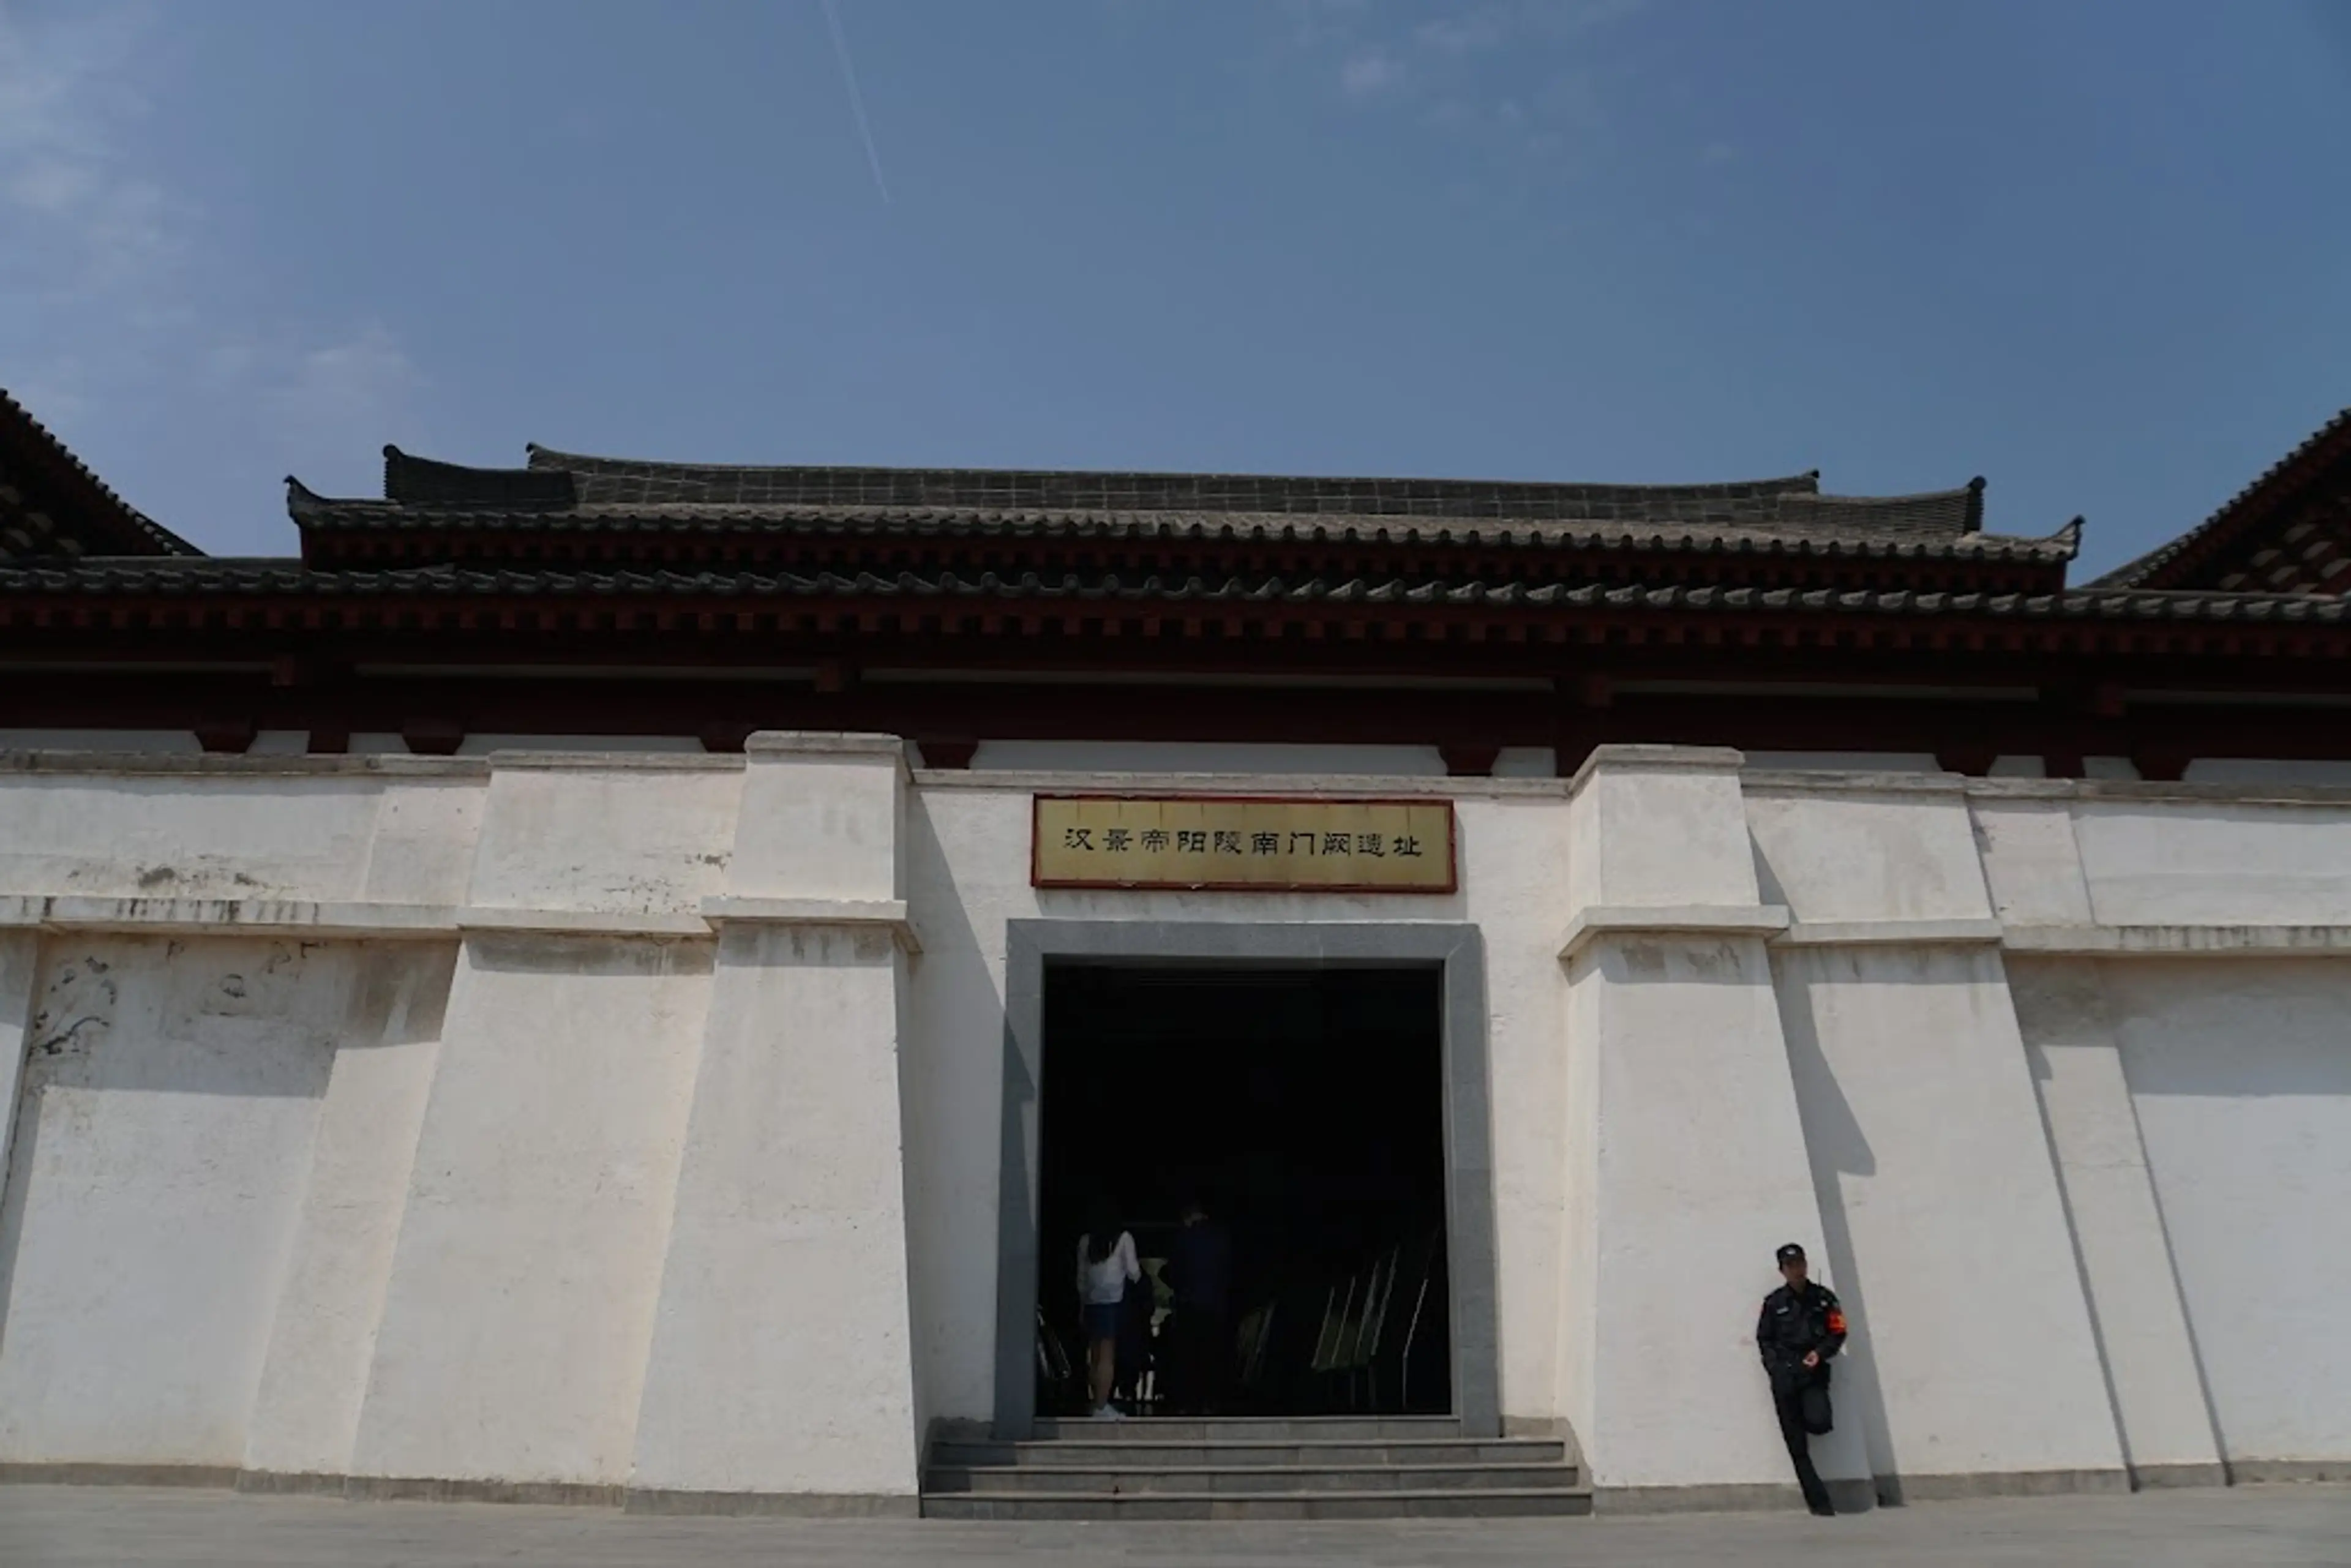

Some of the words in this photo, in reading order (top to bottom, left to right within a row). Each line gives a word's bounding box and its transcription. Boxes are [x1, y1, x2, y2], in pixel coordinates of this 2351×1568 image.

[1064, 828, 1422, 858] 汉景帝阳陵南门阙遗址
